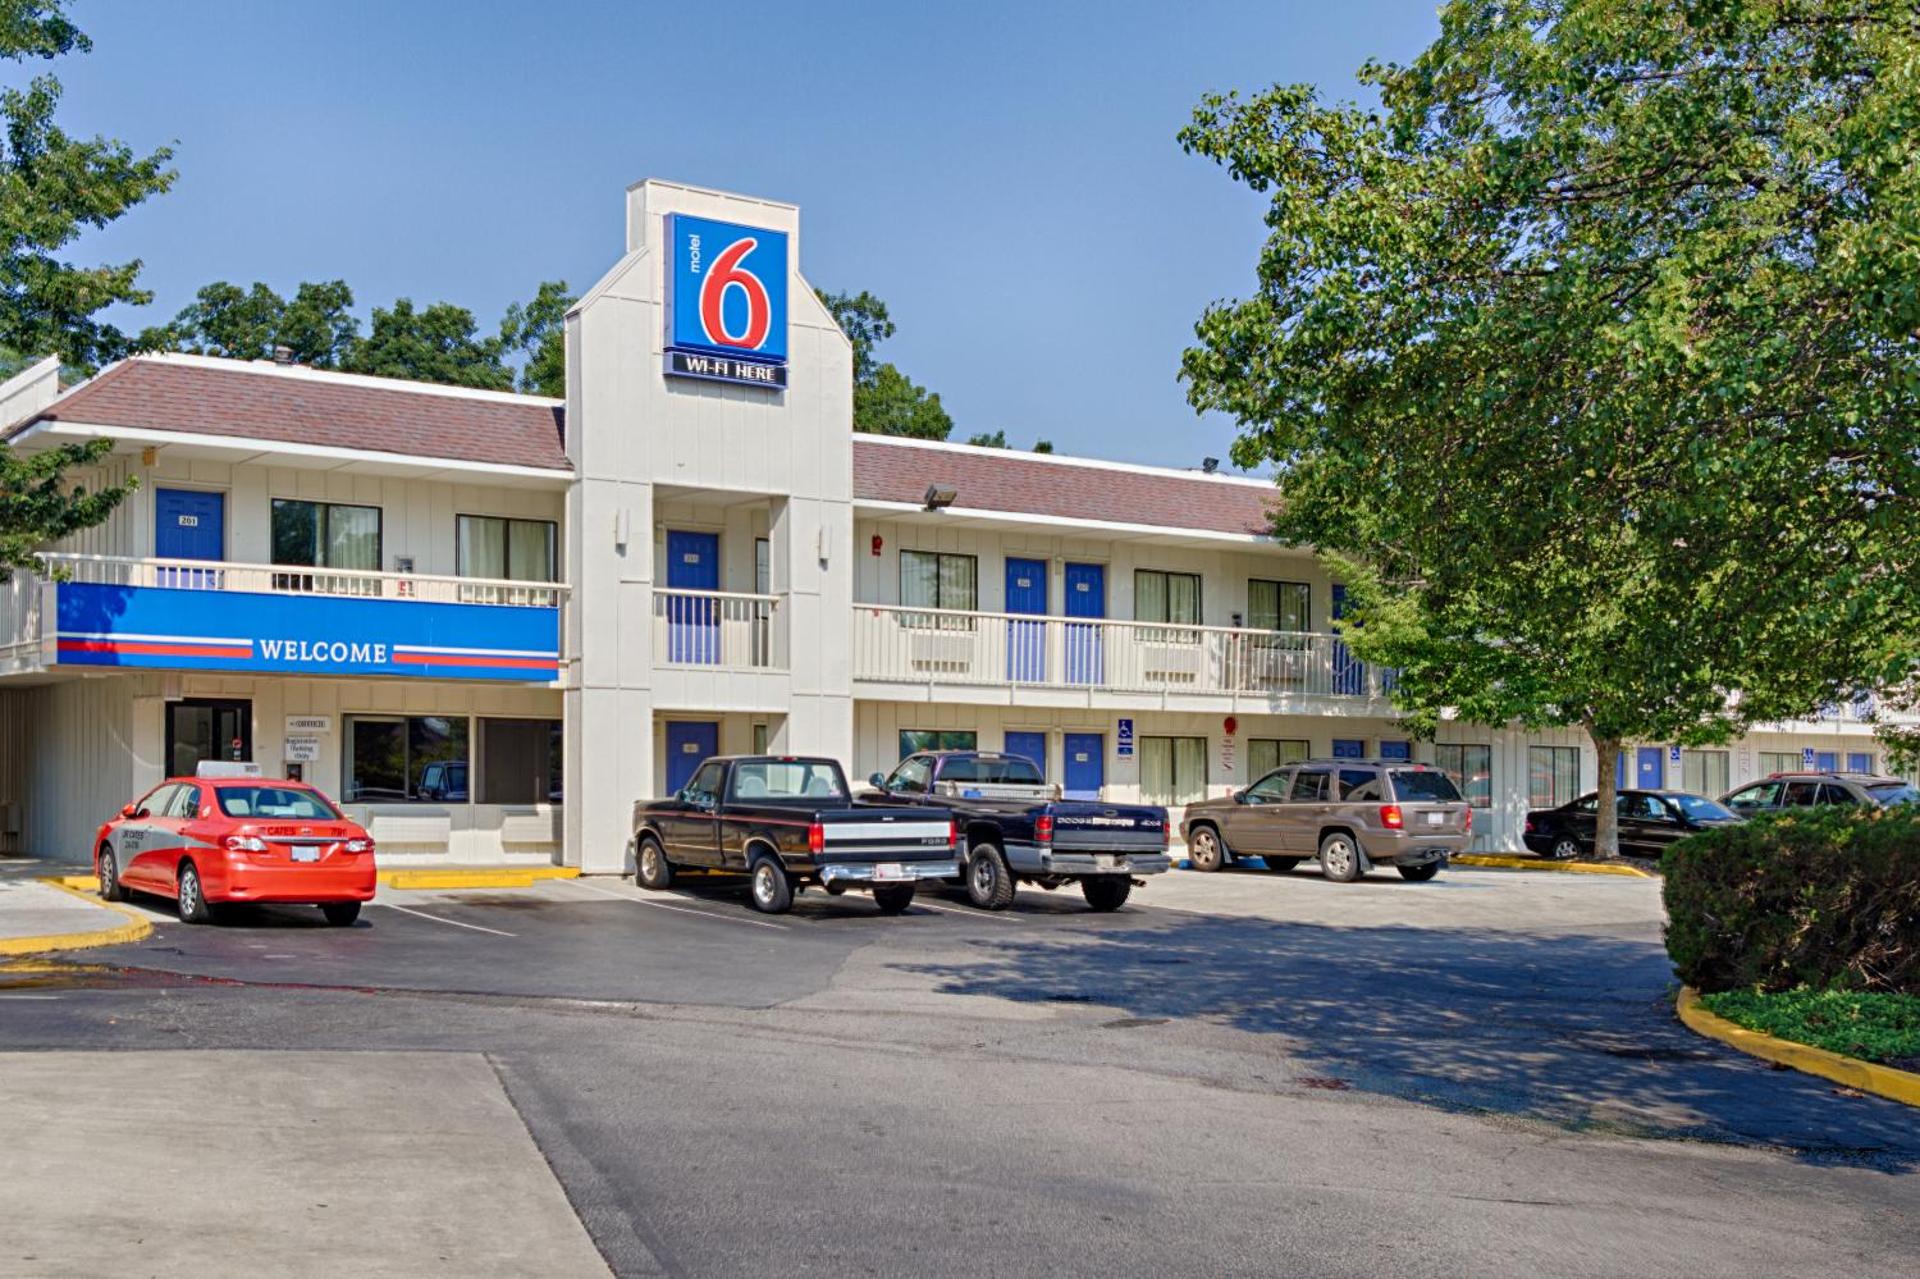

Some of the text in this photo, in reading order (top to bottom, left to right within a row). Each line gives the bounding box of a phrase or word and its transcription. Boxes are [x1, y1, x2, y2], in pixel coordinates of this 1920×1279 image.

[688, 234, 700, 273] motel
[699, 237, 771, 350] 6
[686, 357, 776, 382] WI-FI HERE
[181, 516, 196, 525] 201
[259, 639, 388, 664] WELCOME
[921, 837, 948, 846] FORD
